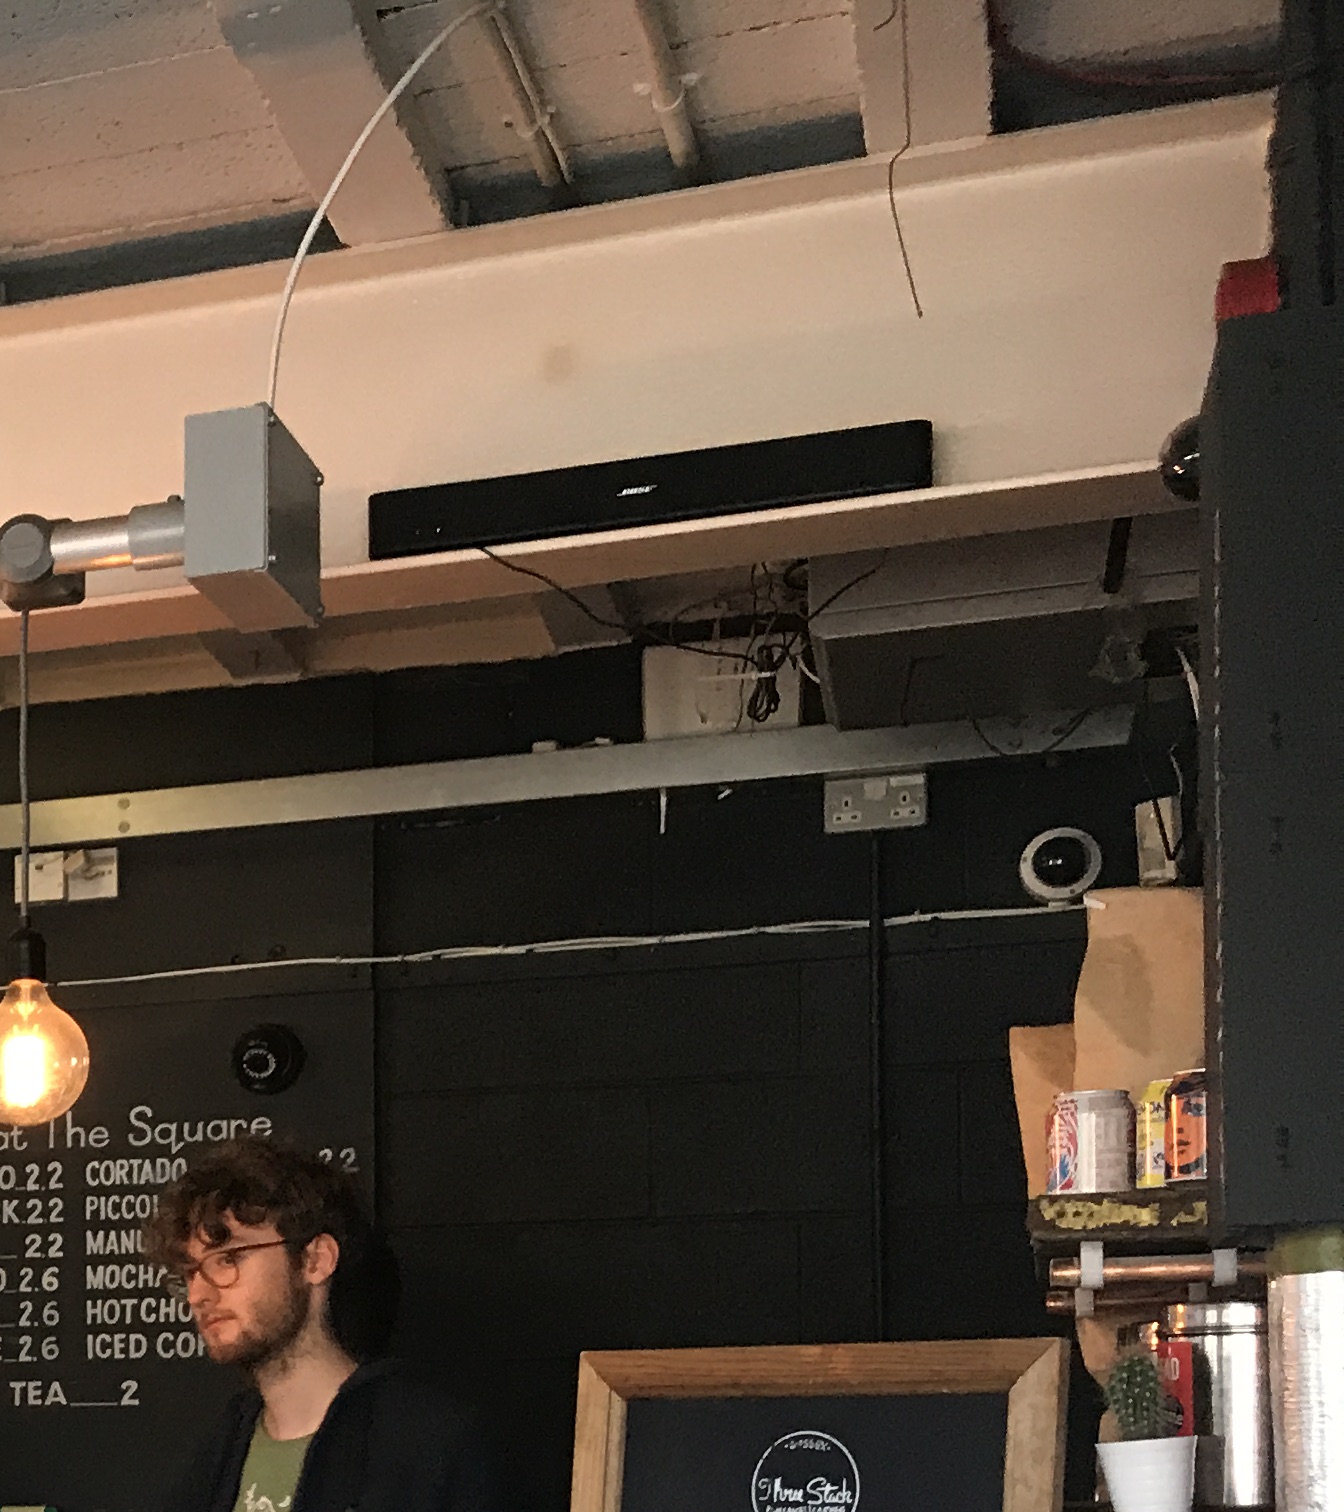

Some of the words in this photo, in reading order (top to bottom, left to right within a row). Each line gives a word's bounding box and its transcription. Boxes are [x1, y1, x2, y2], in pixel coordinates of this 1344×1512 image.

[127, 1105, 273, 1155] Square
[25, 1161, 64, 1191] 2.2
[86, 1157, 188, 1187] CORTADO
[18, 1266, 60, 1293] 2.6
[18, 1300, 60, 1328] 2.6
[18, 1335, 60, 1363] 2.6
[87, 1333, 148, 1360] ICED
[9, 1381, 68, 1407] TEA
[120, 1379, 140, 1407] 2
[758, 1476, 804, 1503] Three
[806, 1476, 853, 1505] Stack
